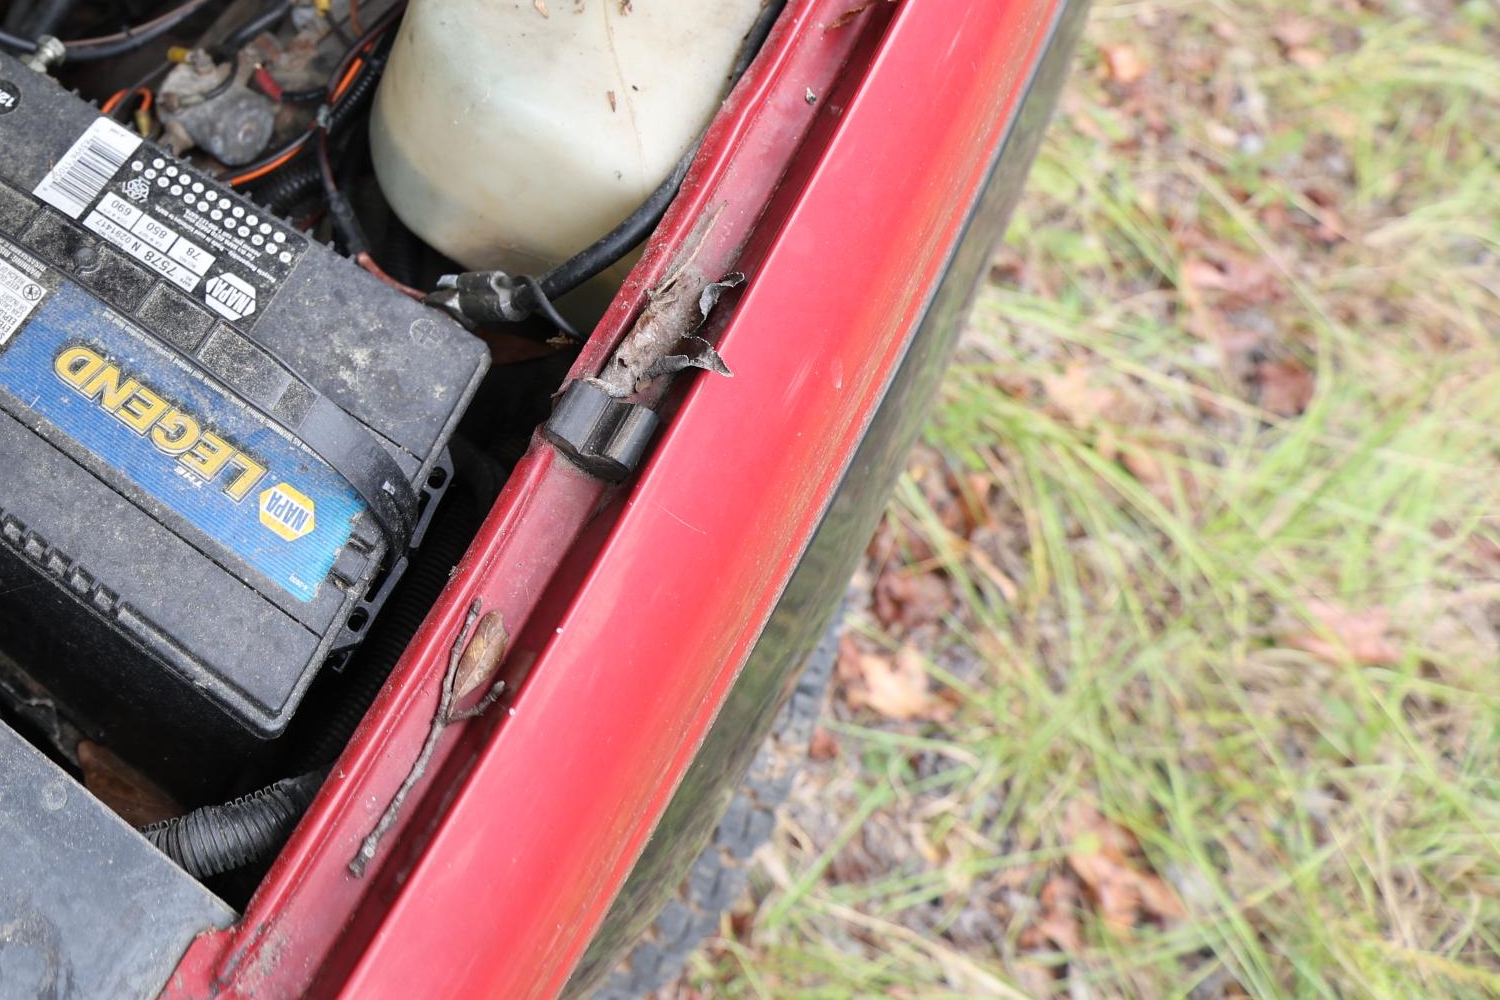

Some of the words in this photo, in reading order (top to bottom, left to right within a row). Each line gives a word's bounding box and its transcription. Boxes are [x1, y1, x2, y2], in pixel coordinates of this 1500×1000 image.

[109, 198, 132, 216] 690
[94, 217, 132, 244] 0291417
[145, 221, 168, 239] 850
[130, 240, 142, 251] N
[184, 246, 202, 260] 78
[9, 253, 42, 279] WARNING:
[142, 249, 178, 277] 7578
[5, 278, 20, 291] KEEP
[6, 269, 26, 285] REACH
[209, 278, 251, 314] NAPA
[53, 345, 268, 503] LEGEND
[172, 463, 204, 489] THE
[263, 489, 309, 533] NAPA
